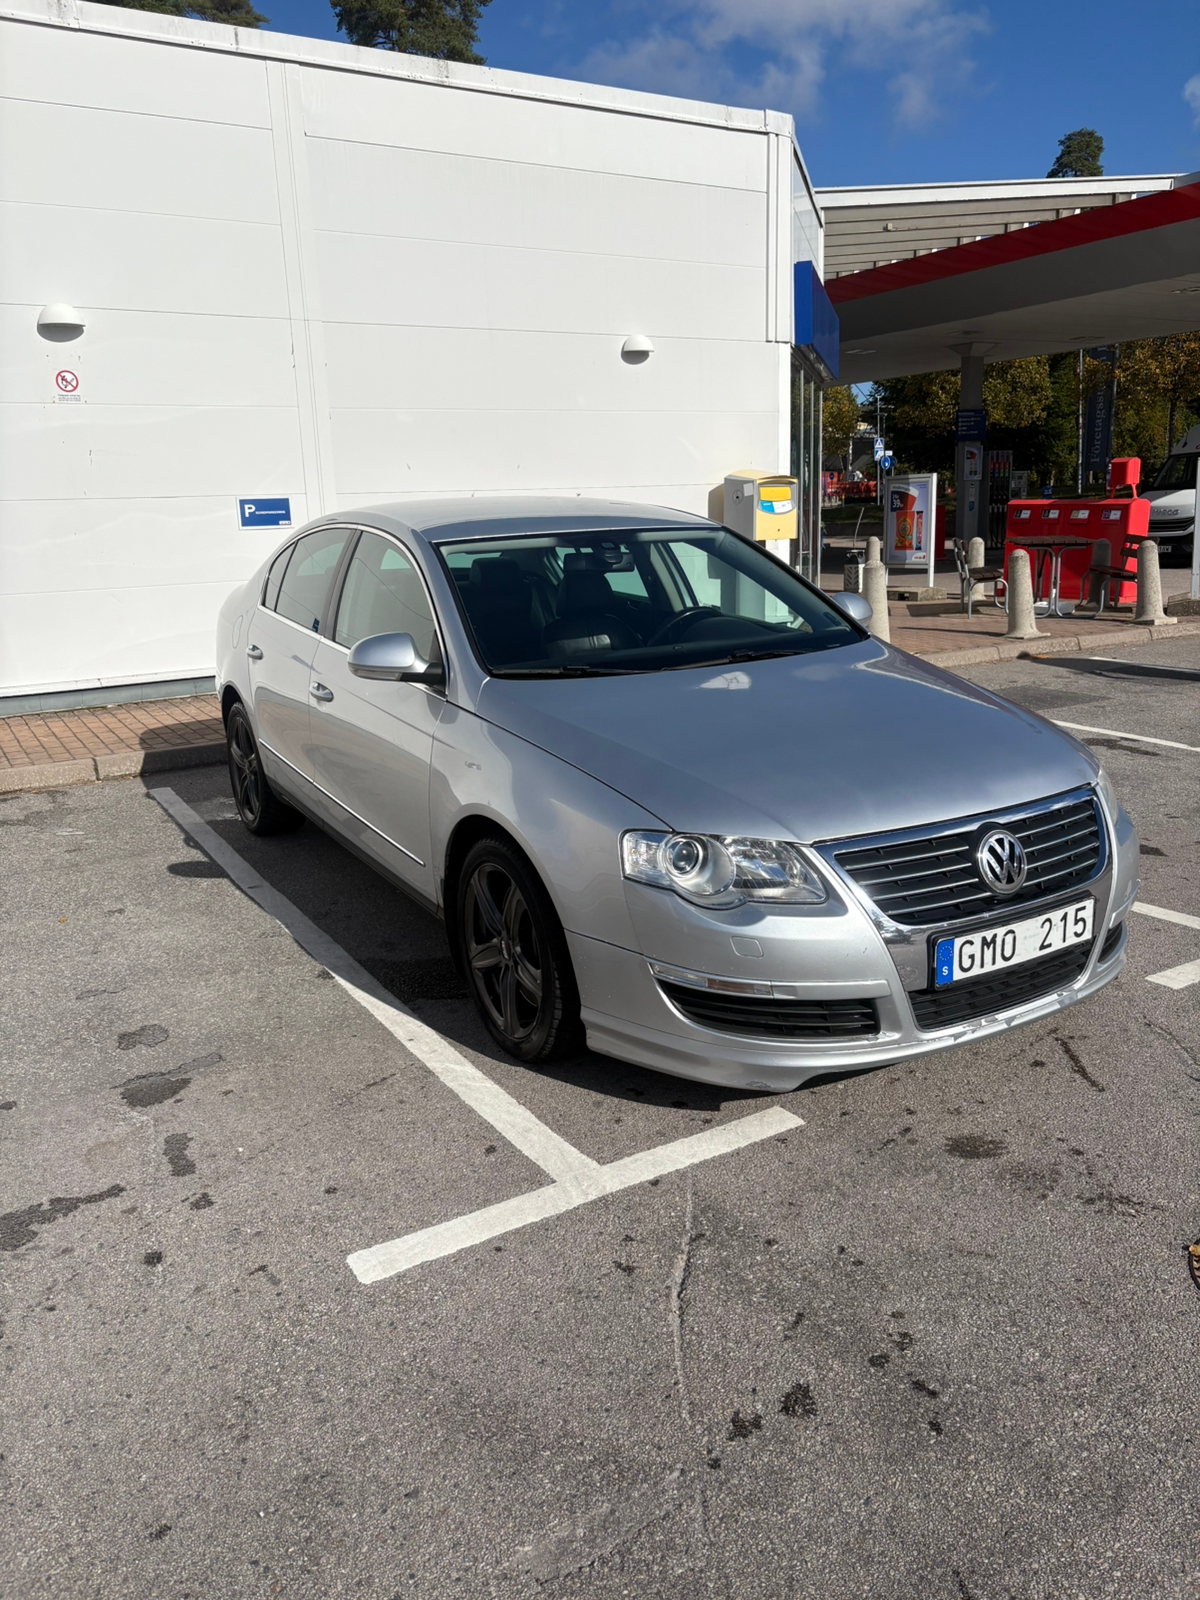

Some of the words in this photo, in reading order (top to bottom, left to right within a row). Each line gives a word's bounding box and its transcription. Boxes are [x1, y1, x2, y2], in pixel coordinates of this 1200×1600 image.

[244, 504, 256, 518] P
[958, 929, 1017, 973] GMO
[1038, 905, 1087, 951] 215
[942, 965, 949, 976] S
